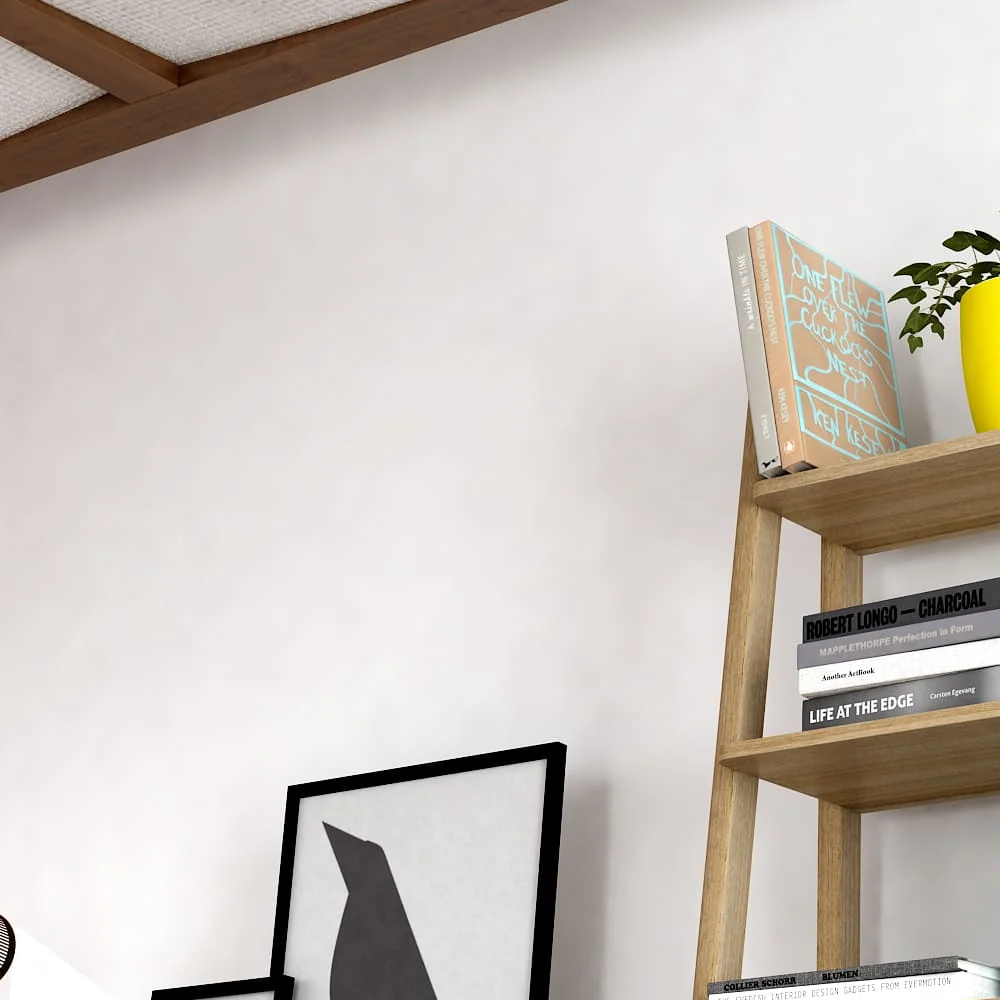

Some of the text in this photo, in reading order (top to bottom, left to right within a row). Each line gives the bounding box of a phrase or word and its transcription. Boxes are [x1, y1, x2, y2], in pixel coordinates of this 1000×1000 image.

[737, 252, 748, 275] TIME
[791, 253, 826, 292] ONE
[802, 286, 838, 322] OVER
[826, 349, 868, 389] NEST
[811, 402, 840, 437] KEN
[806, 613, 855, 640] ROBERT
[857, 605, 898, 630] LONGO
[918, 588, 987, 618] CHARCOAL
[819, 623, 974, 657] MAPPLETHORPE Perfection in Form
[821, 671, 847, 681] Another
[809, 693, 914, 723] LIFE AT THE EDGE
[929, 686, 976, 700] Carsten Egevang
[723, 976, 797, 992] COLLIER SCHORR
[812, 987, 839, 998] DESIGN
[843, 983, 876, 995] GADGETS
[880, 981, 900, 991] FROM
[904, 976, 951, 989] EVERMOTION
[822, 969, 860, 981] BLUMEN
